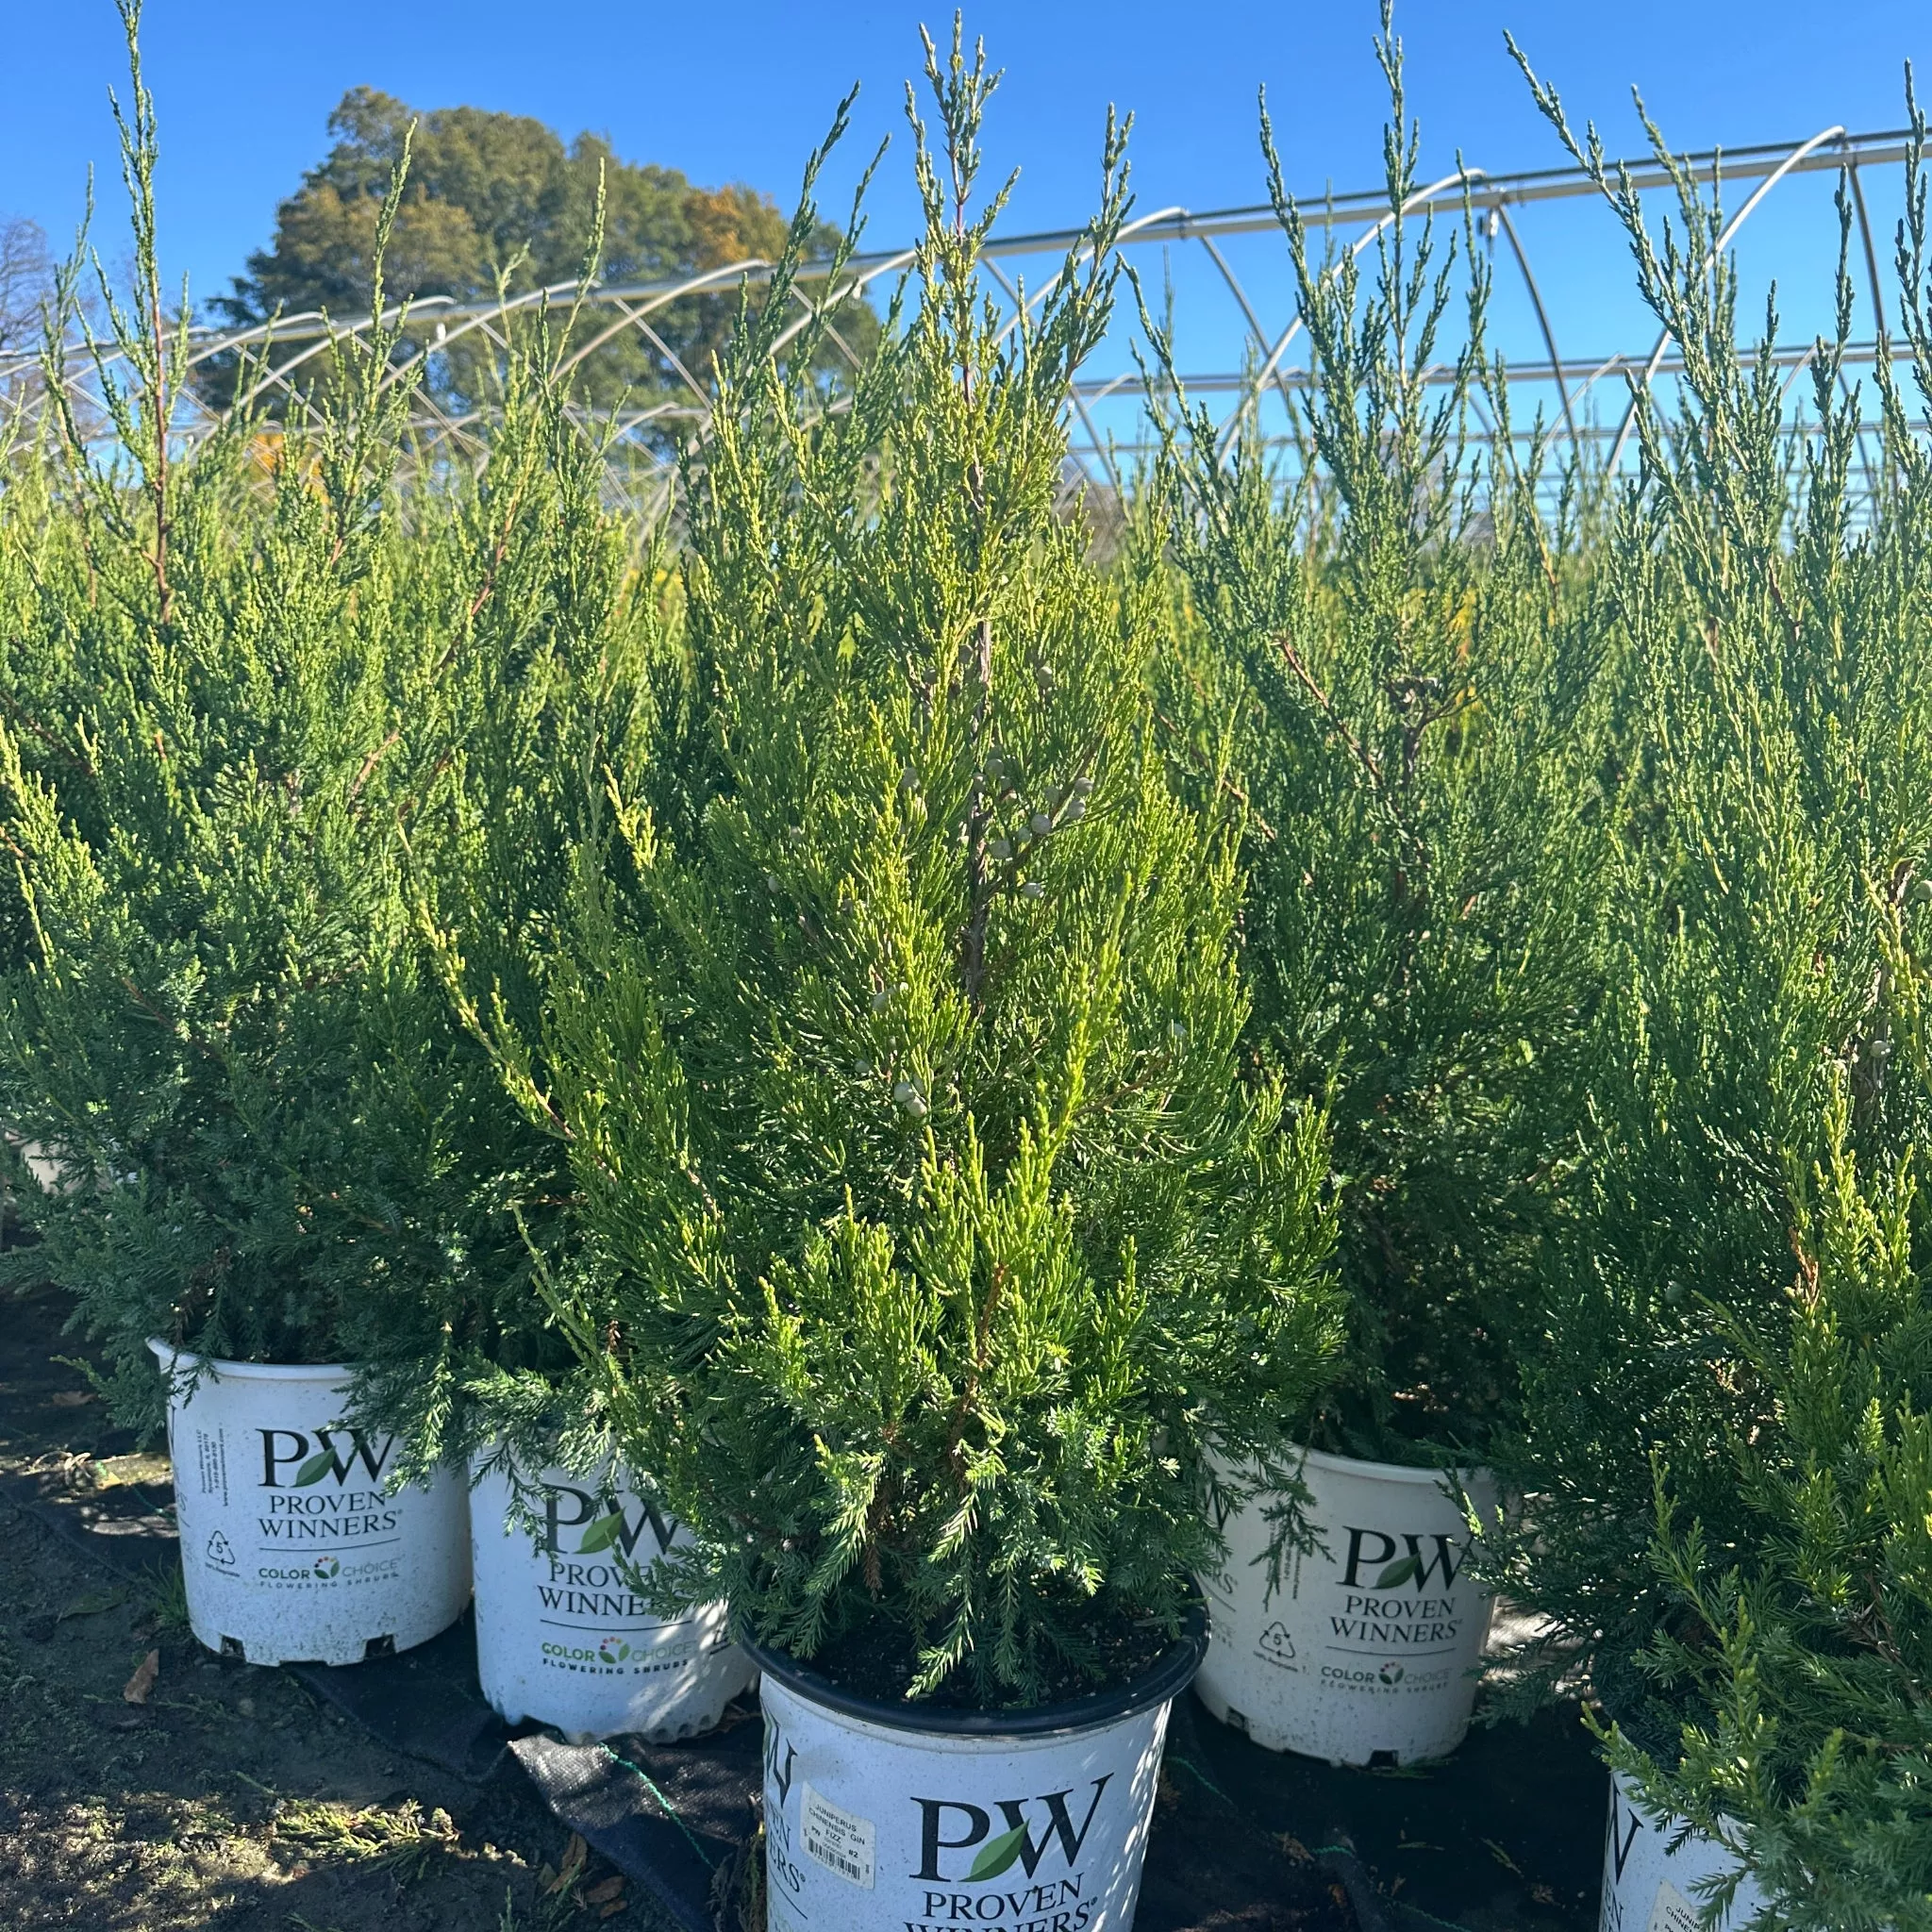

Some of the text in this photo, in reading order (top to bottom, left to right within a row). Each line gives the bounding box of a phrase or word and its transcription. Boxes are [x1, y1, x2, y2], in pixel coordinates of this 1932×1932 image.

[255, 1428, 395, 1488] PW
[270, 1491, 387, 1515] PROVEN
[258, 1568, 310, 1579] COLOR
[342, 1557, 399, 1577] CHOICE
[1335, 1525, 1474, 1593] PW
[259, 1580, 338, 1590] FLOWERING
[1345, 1594, 1457, 1619] PROVEN
[1329, 1616, 1458, 1643] WINNERS
[541, 1641, 692, 1662] COLOR CHOICE
[542, 1658, 689, 1674] FLOWERING SHRUBS
[1321, 1666, 1375, 1683] COLOR
[815, 1804, 857, 1832] JUNIPERUS
[909, 1772, 1115, 1883] PW
[825, 1828, 841, 1842] FIZZ
[850, 1833, 865, 1845] GIN
[848, 1849, 858, 1858] #2
[922, 1872, 1085, 1921] PROVEN
